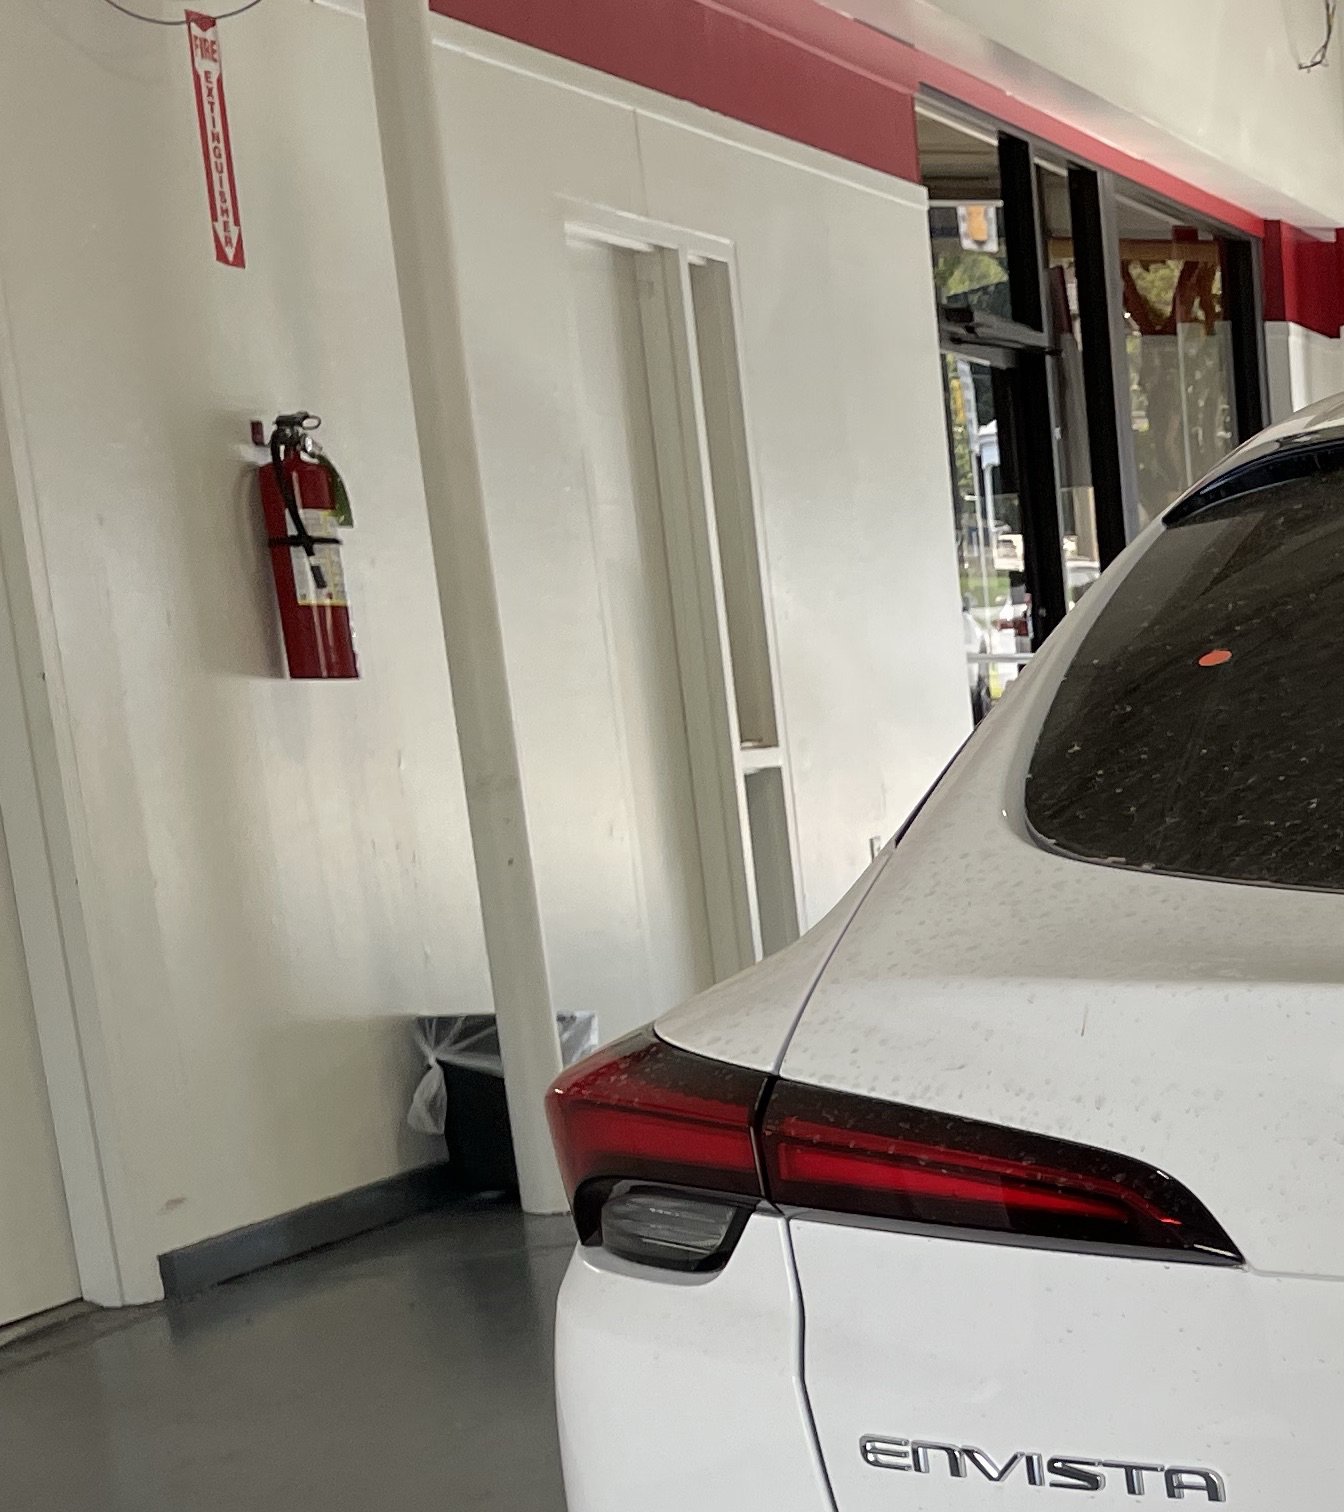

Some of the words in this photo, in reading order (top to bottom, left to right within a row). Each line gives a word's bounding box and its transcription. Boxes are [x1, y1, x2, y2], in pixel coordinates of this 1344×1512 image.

[193, 35, 219, 63] FIRE
[203, 70, 234, 249] EXTINGUISHER
[858, 1433, 1227, 1502] ENVISTA
